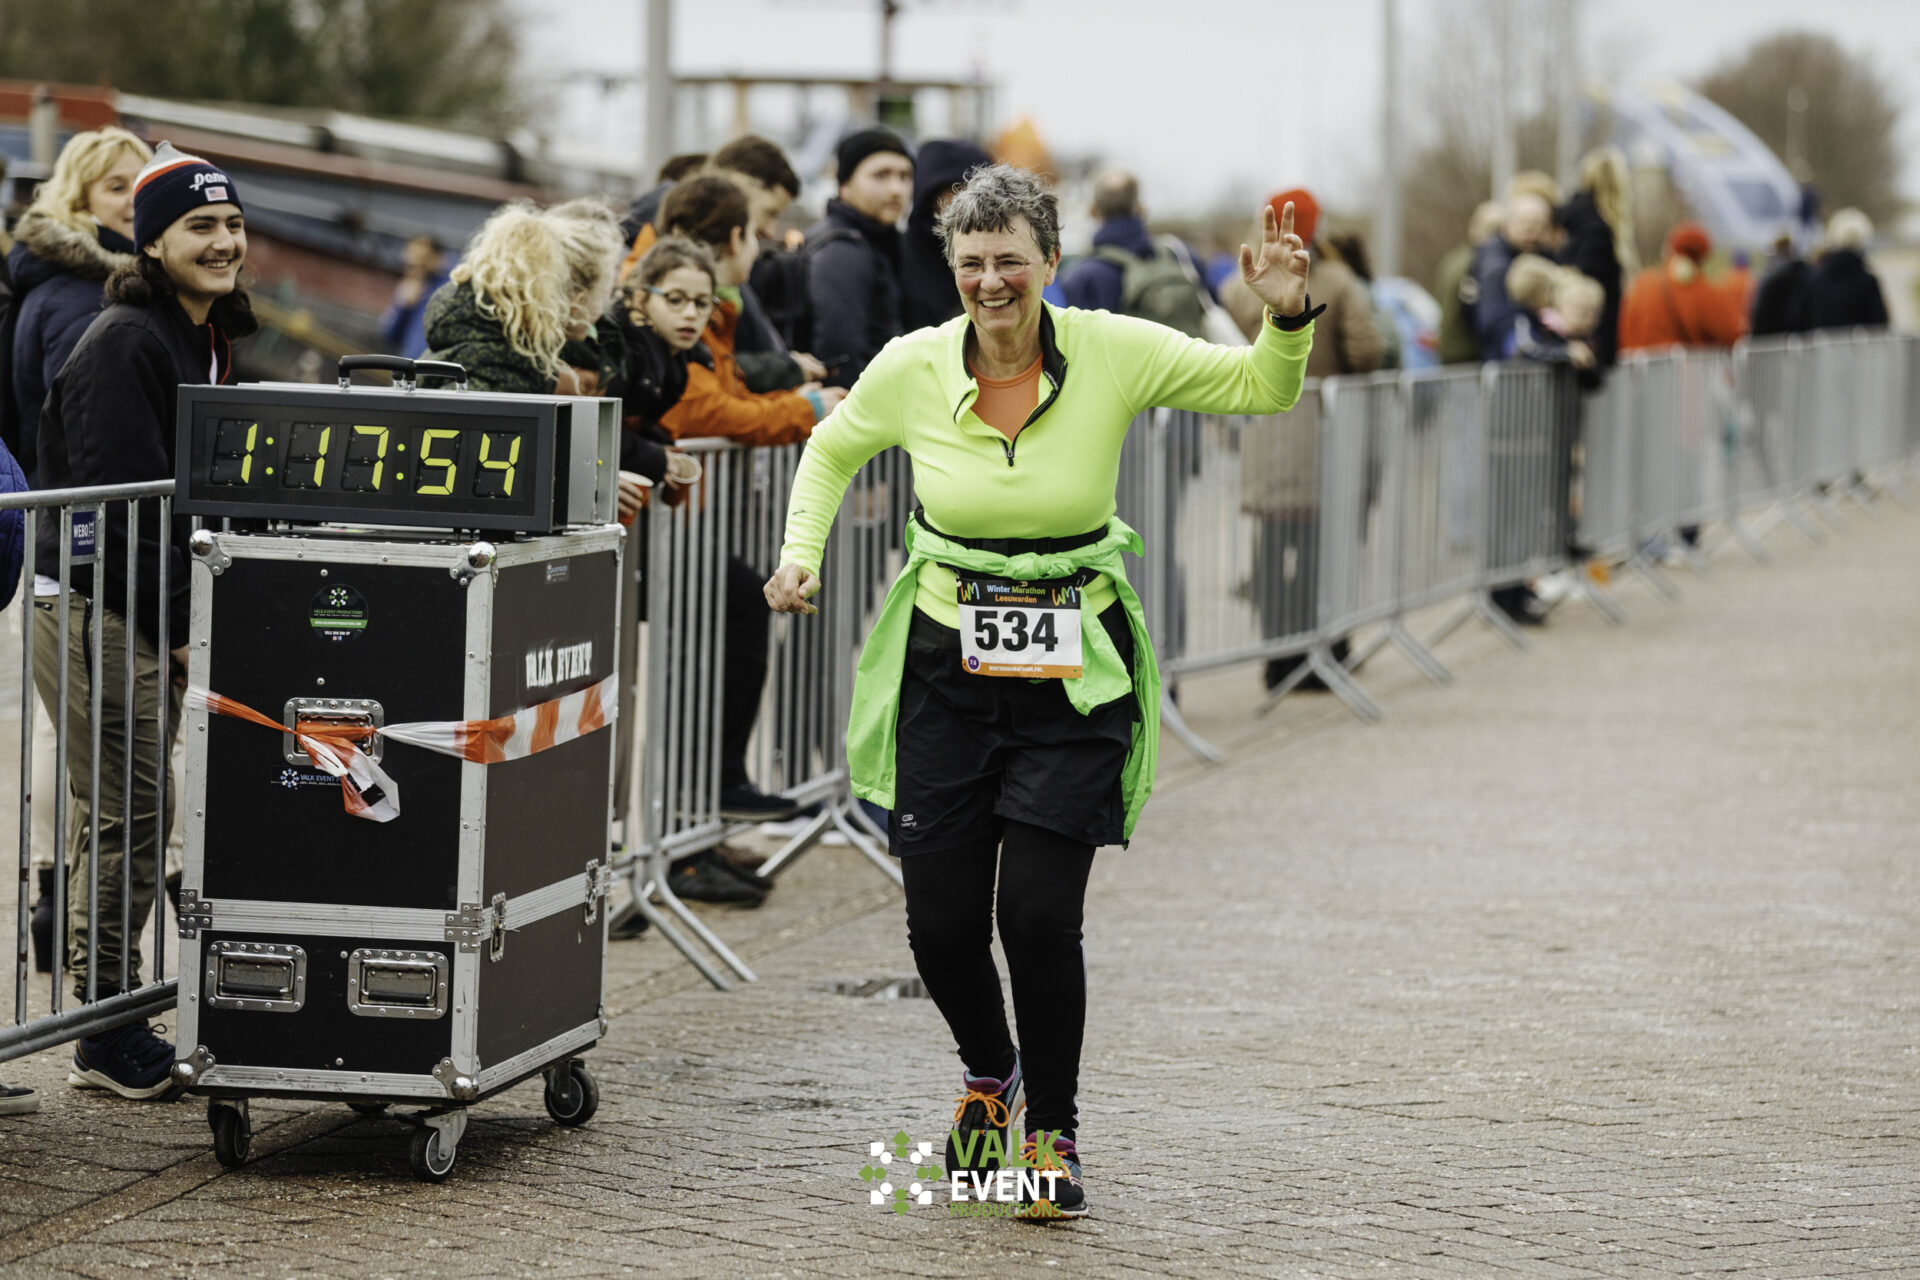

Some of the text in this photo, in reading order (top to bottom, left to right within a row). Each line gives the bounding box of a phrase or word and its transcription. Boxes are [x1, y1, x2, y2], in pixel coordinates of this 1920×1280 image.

[241, 423, 521, 496] 1:17:54
[986, 584, 1046, 595] Winter Marathon
[994, 594, 1038, 604] Leeuwarden
[975, 610, 1059, 652] 534
[556, 641, 592, 684] EVENT
